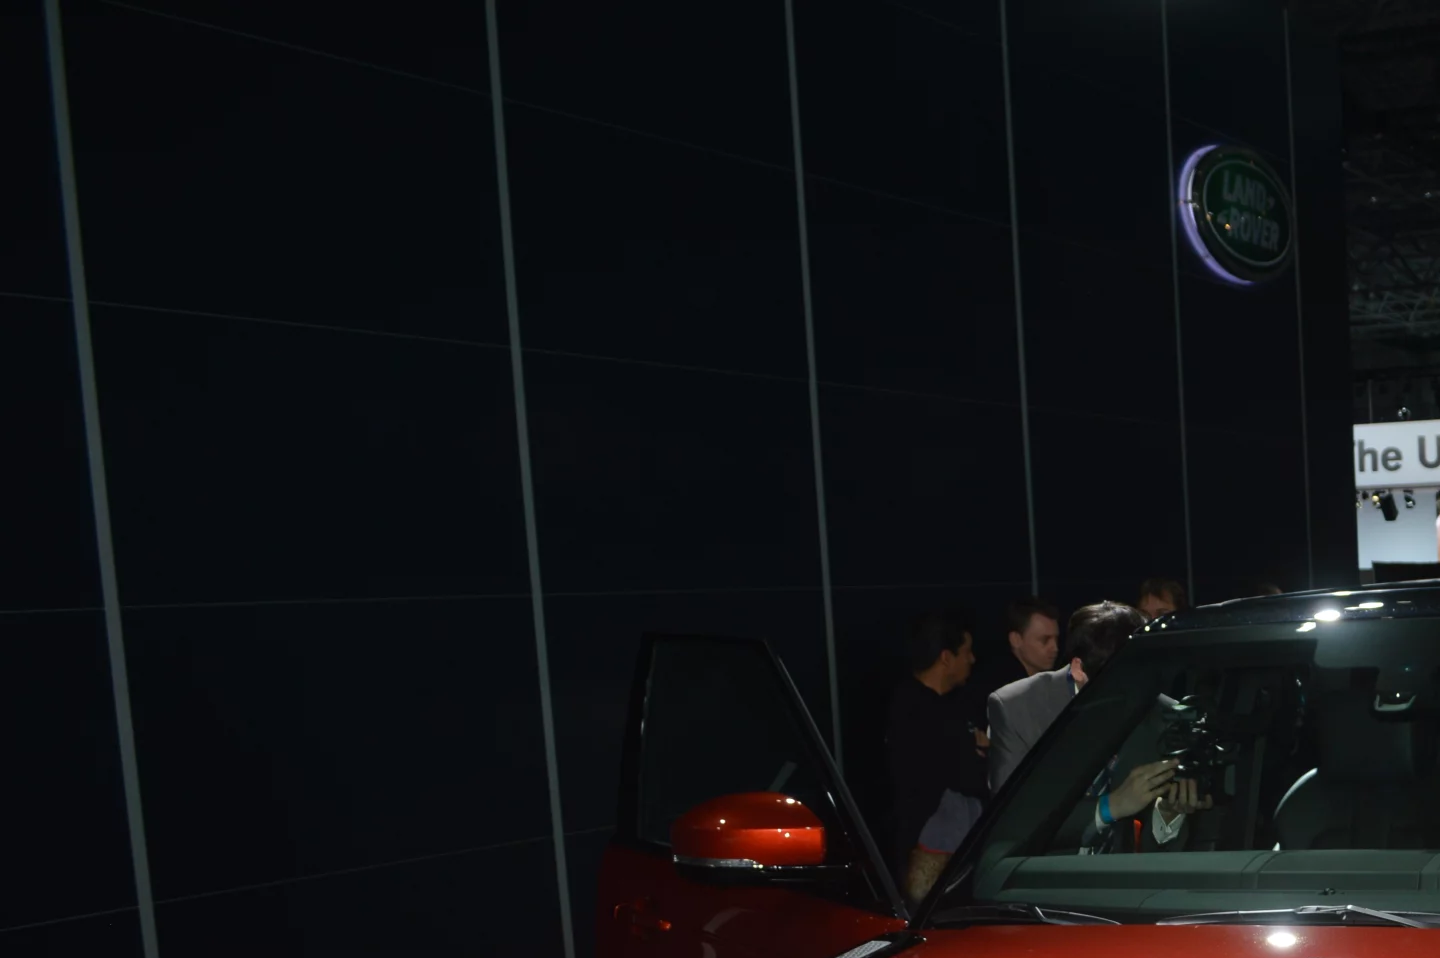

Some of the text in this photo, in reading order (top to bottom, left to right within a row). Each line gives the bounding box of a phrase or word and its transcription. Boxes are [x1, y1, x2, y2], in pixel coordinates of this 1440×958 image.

[1223, 170, 1266, 211] LAND
[1229, 207, 1280, 251] ROVER
[1353, 438, 1403, 472] he
